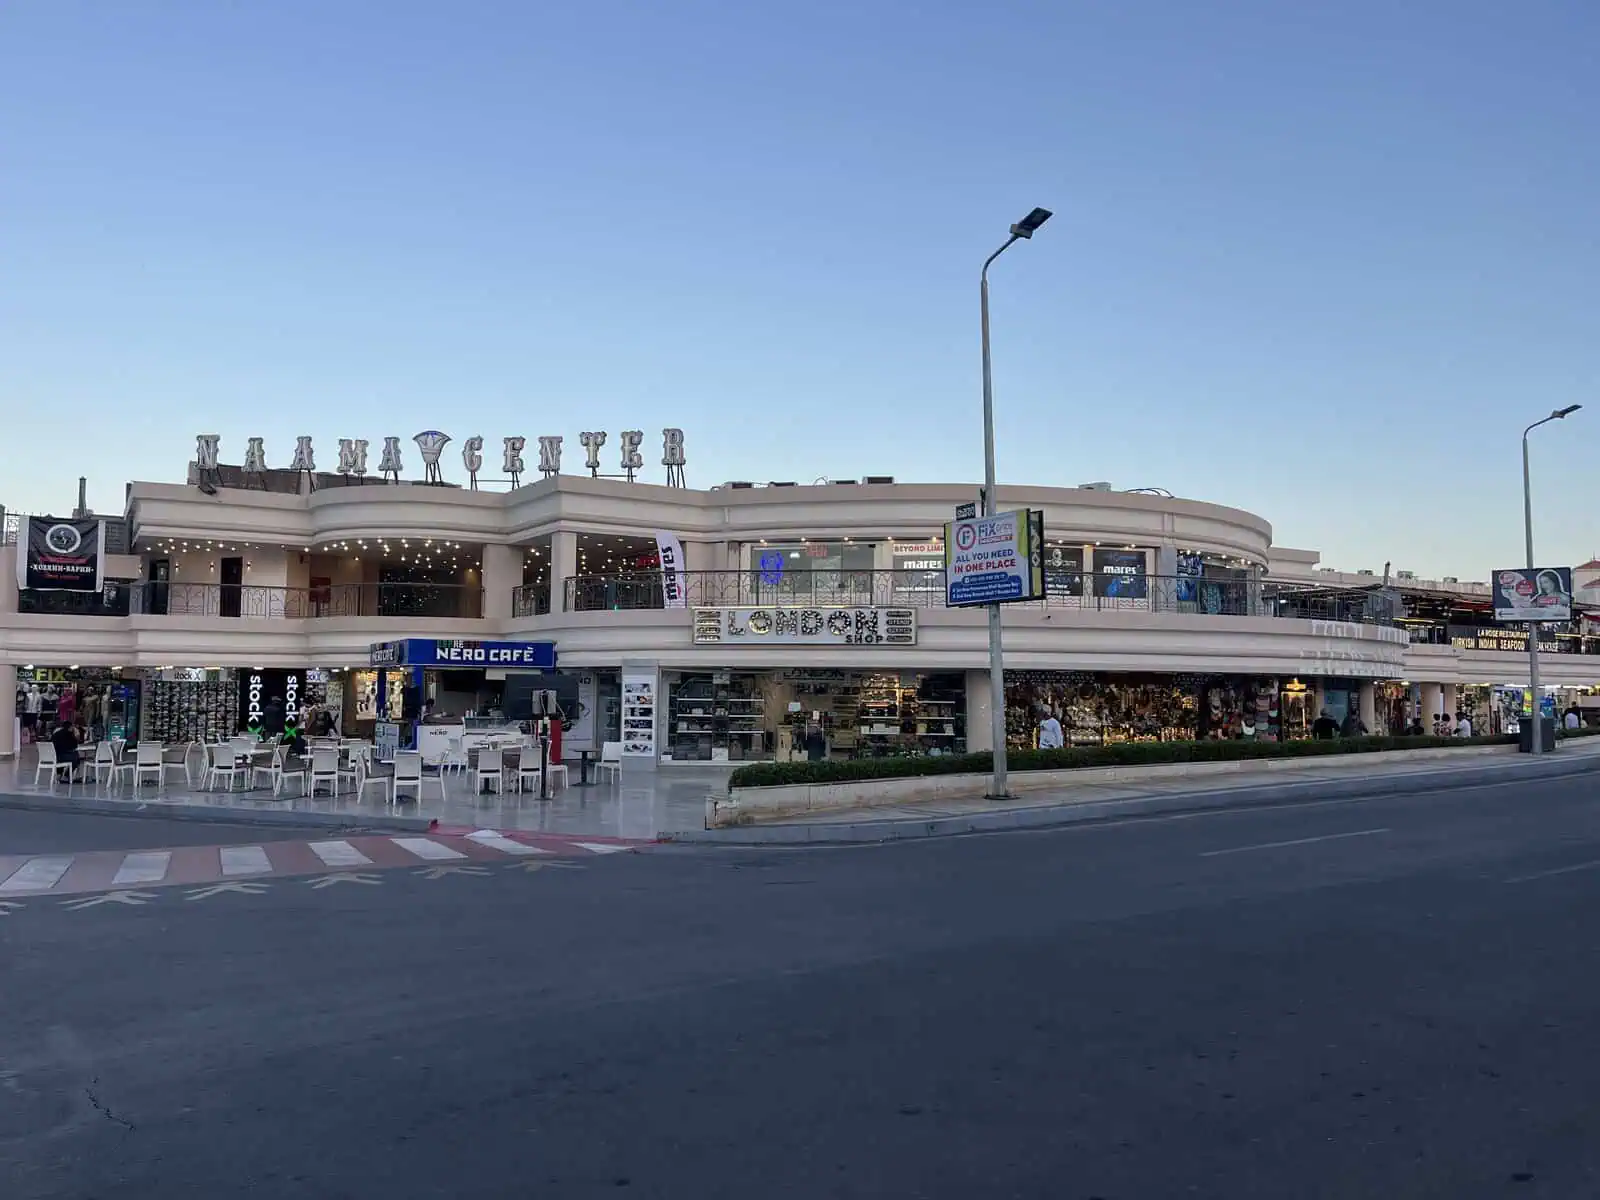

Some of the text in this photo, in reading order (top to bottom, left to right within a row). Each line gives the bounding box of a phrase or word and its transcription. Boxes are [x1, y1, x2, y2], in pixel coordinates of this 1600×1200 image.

[196, 427, 687, 474] NAAMA CENTER
[955, 549, 1013, 563] ALL YOU NEED
[903, 560, 943, 569] mares
[954, 559, 1016, 574] IN ONE PLACE
[1103, 565, 1137, 575] mares
[661, 546, 678, 600] mares
[728, 610, 879, 636] LONDON
[846, 634, 883, 644] SHOP
[1451, 637, 1475, 649] TURKISH
[1478, 638, 1497, 650] INDIAN
[1500, 640, 1525, 651] SEAFOOD
[436, 648, 485, 661] NERO
[36, 669, 65, 681] FIX
[248, 675, 264, 723] stock
[285, 675, 299, 722] stock
